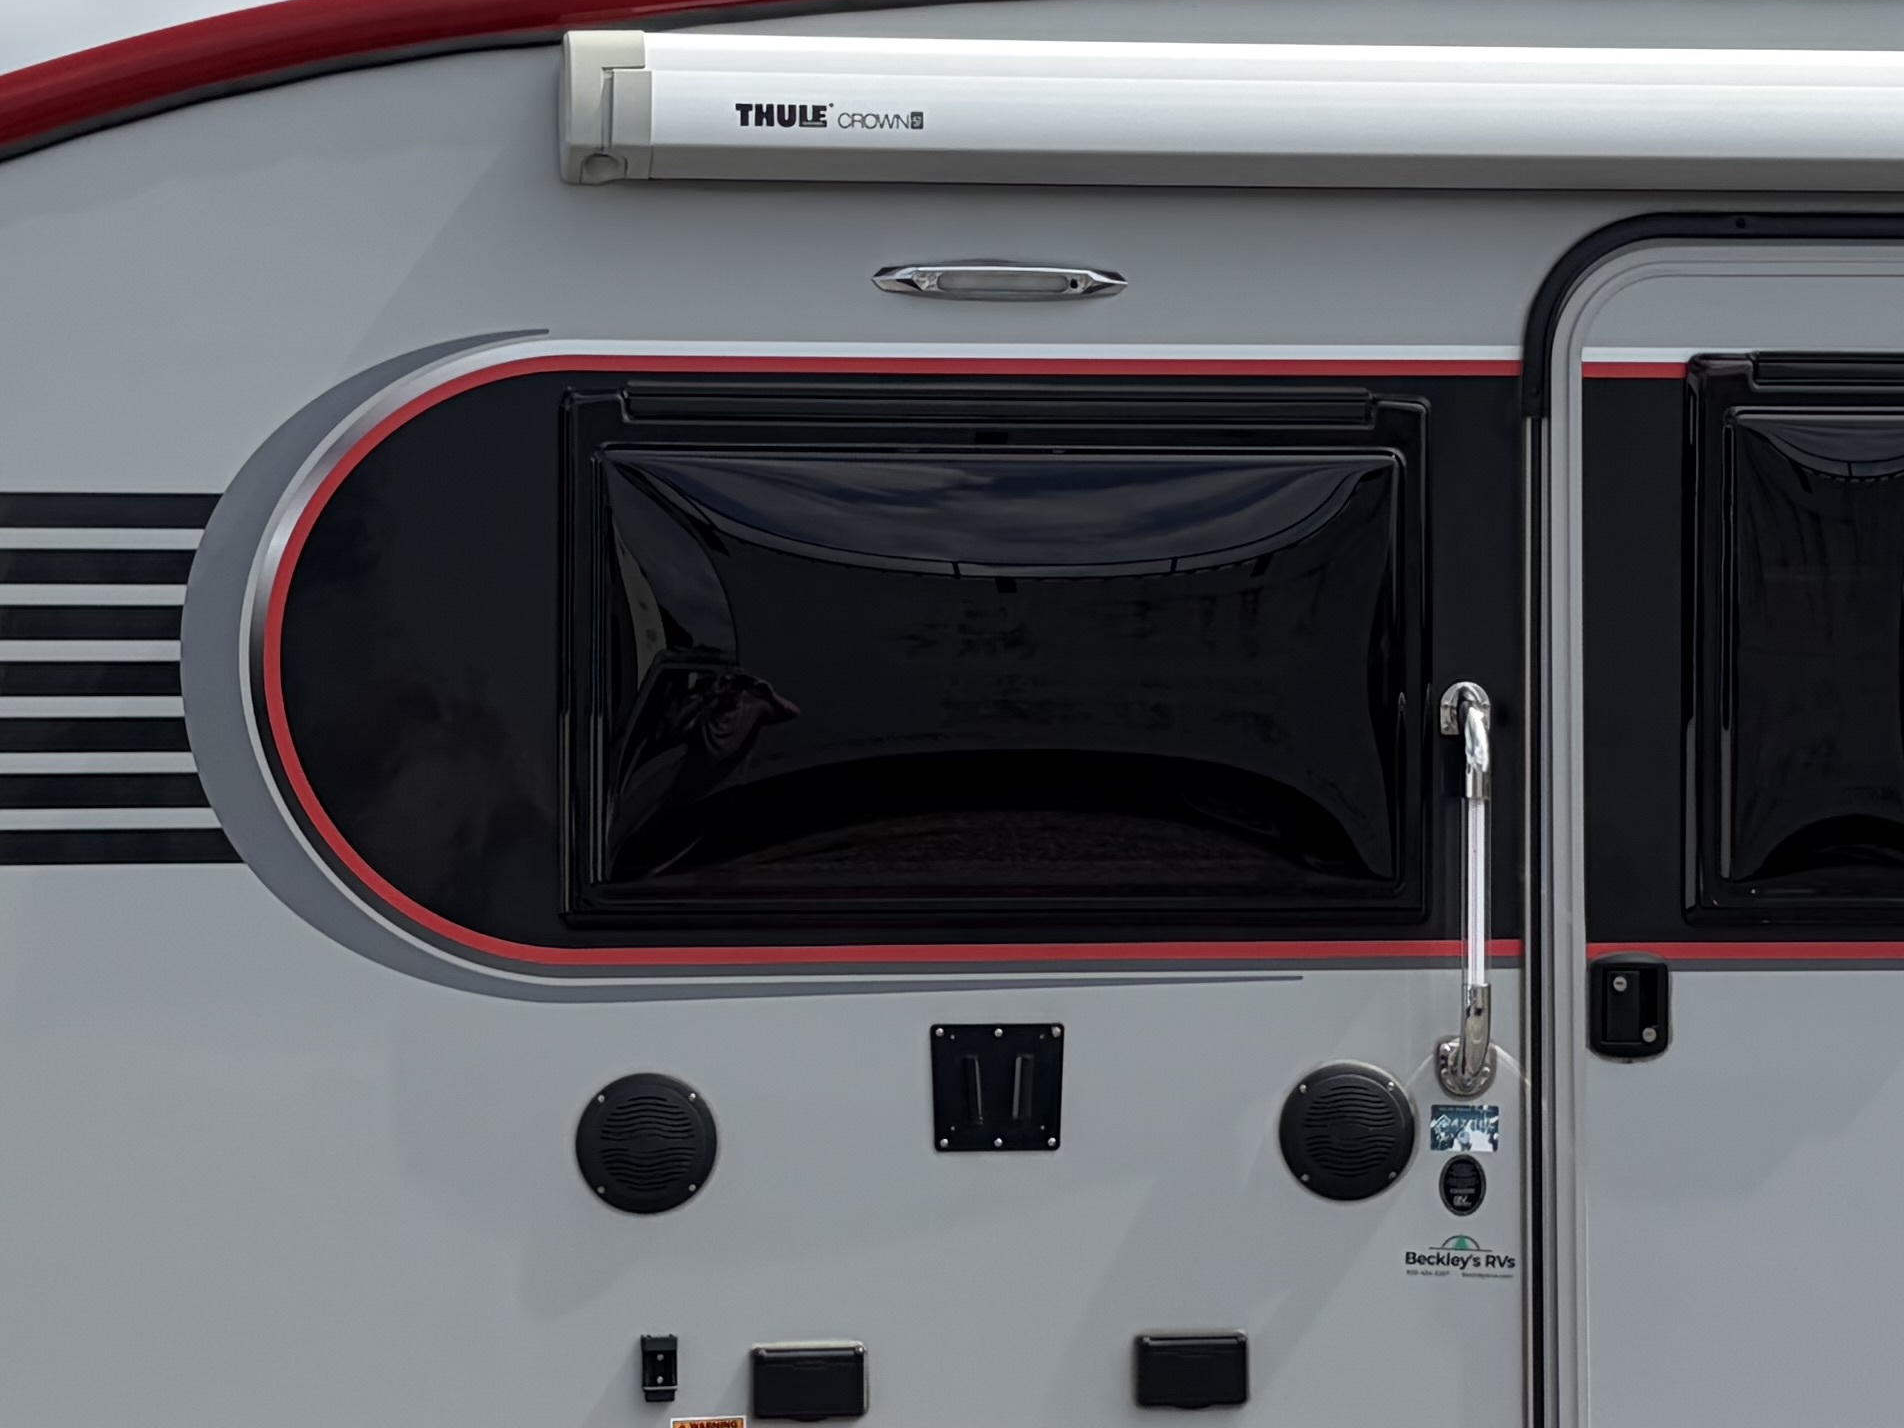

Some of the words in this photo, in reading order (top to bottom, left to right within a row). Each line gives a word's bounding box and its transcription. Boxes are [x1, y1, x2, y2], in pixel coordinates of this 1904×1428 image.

[735, 103, 827, 128] THULE
[1405, 1251, 1481, 1270] Beckley's
[1485, 1254, 1516, 1268] RVs
